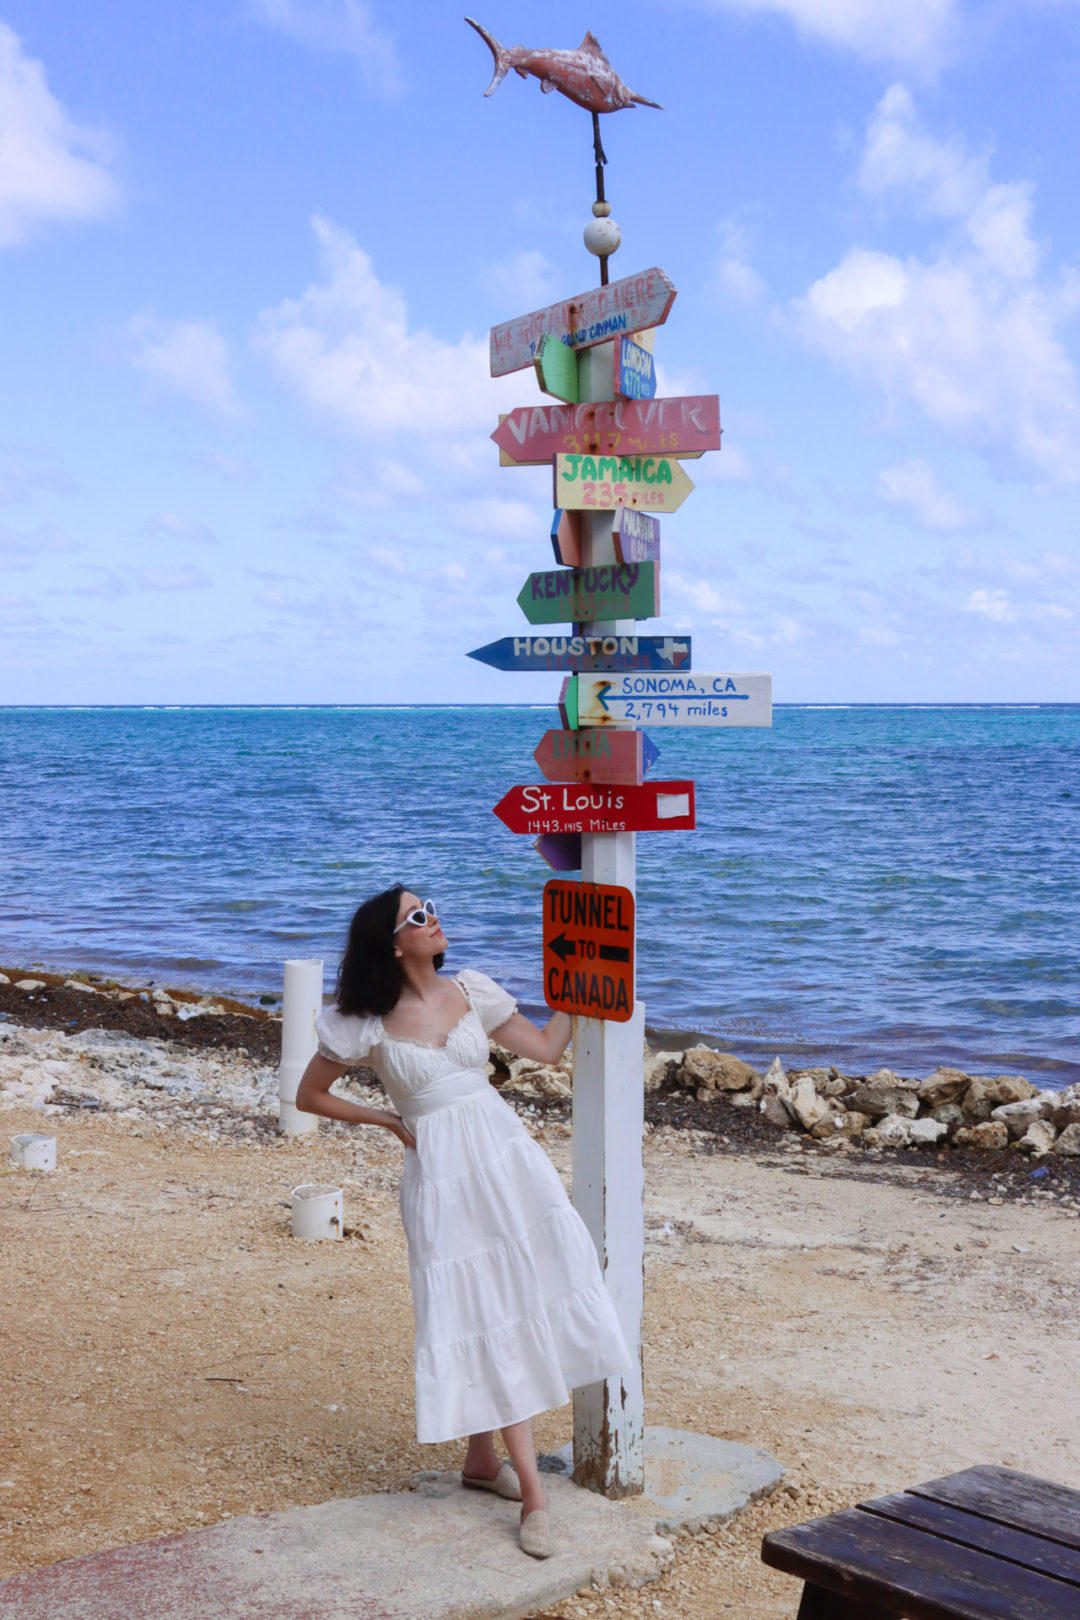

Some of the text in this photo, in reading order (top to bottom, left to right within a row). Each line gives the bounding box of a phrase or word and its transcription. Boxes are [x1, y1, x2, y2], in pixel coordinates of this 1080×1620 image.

[493, 326, 514, 353] WE
[520, 314, 545, 344] GOT
[614, 274, 656, 309] HERE
[589, 314, 627, 340] CAYMAN
[622, 339, 652, 381] LONDON
[508, 400, 709, 444] VANCOUVER
[562, 454, 673, 484] JAMAICA
[582, 482, 629, 507] 235
[531, 563, 640, 600] KENTUCKY
[513, 637, 639, 656] HOUSTON
[622, 677, 737, 694] SONOMA, CA
[624, 701, 728, 720] 2,794 miles
[551, 731, 612, 759] INDIA
[521, 786, 624, 813] St. Louis
[547, 889, 630, 931] TUNNEL
[578, 939, 596, 960] TO
[548, 967, 629, 1014] CANADA
